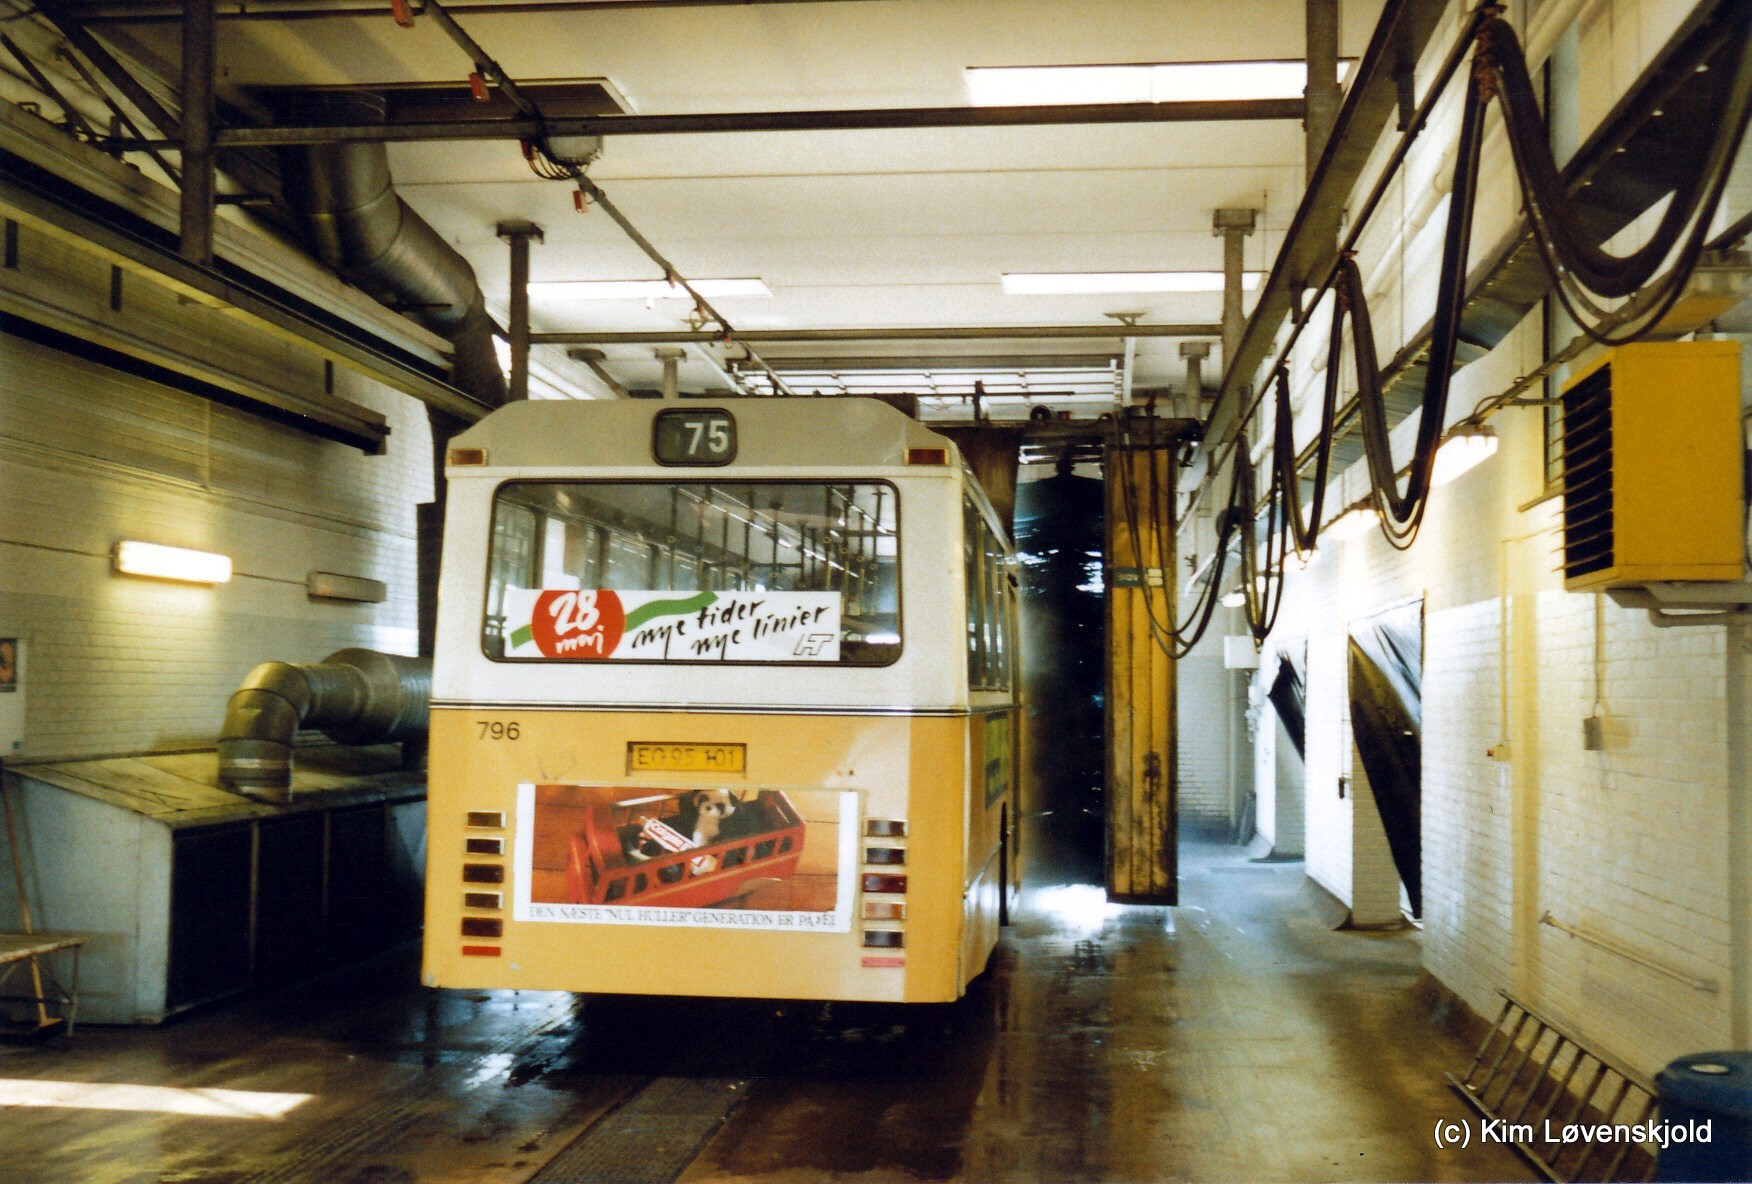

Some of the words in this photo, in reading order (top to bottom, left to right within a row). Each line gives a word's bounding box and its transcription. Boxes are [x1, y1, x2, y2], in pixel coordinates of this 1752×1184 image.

[684, 420, 730, 455] 75
[548, 590, 600, 634] 28
[632, 621, 685, 660] nye
[698, 599, 765, 628] tider
[555, 625, 604, 654] maj
[690, 628, 740, 661] nye
[752, 605, 832, 641] linier
[477, 721, 521, 740] 796
[530, 906, 555, 918] DEN
[693, 911, 773, 926] GENERATION
[778, 914, 794, 926] ER
